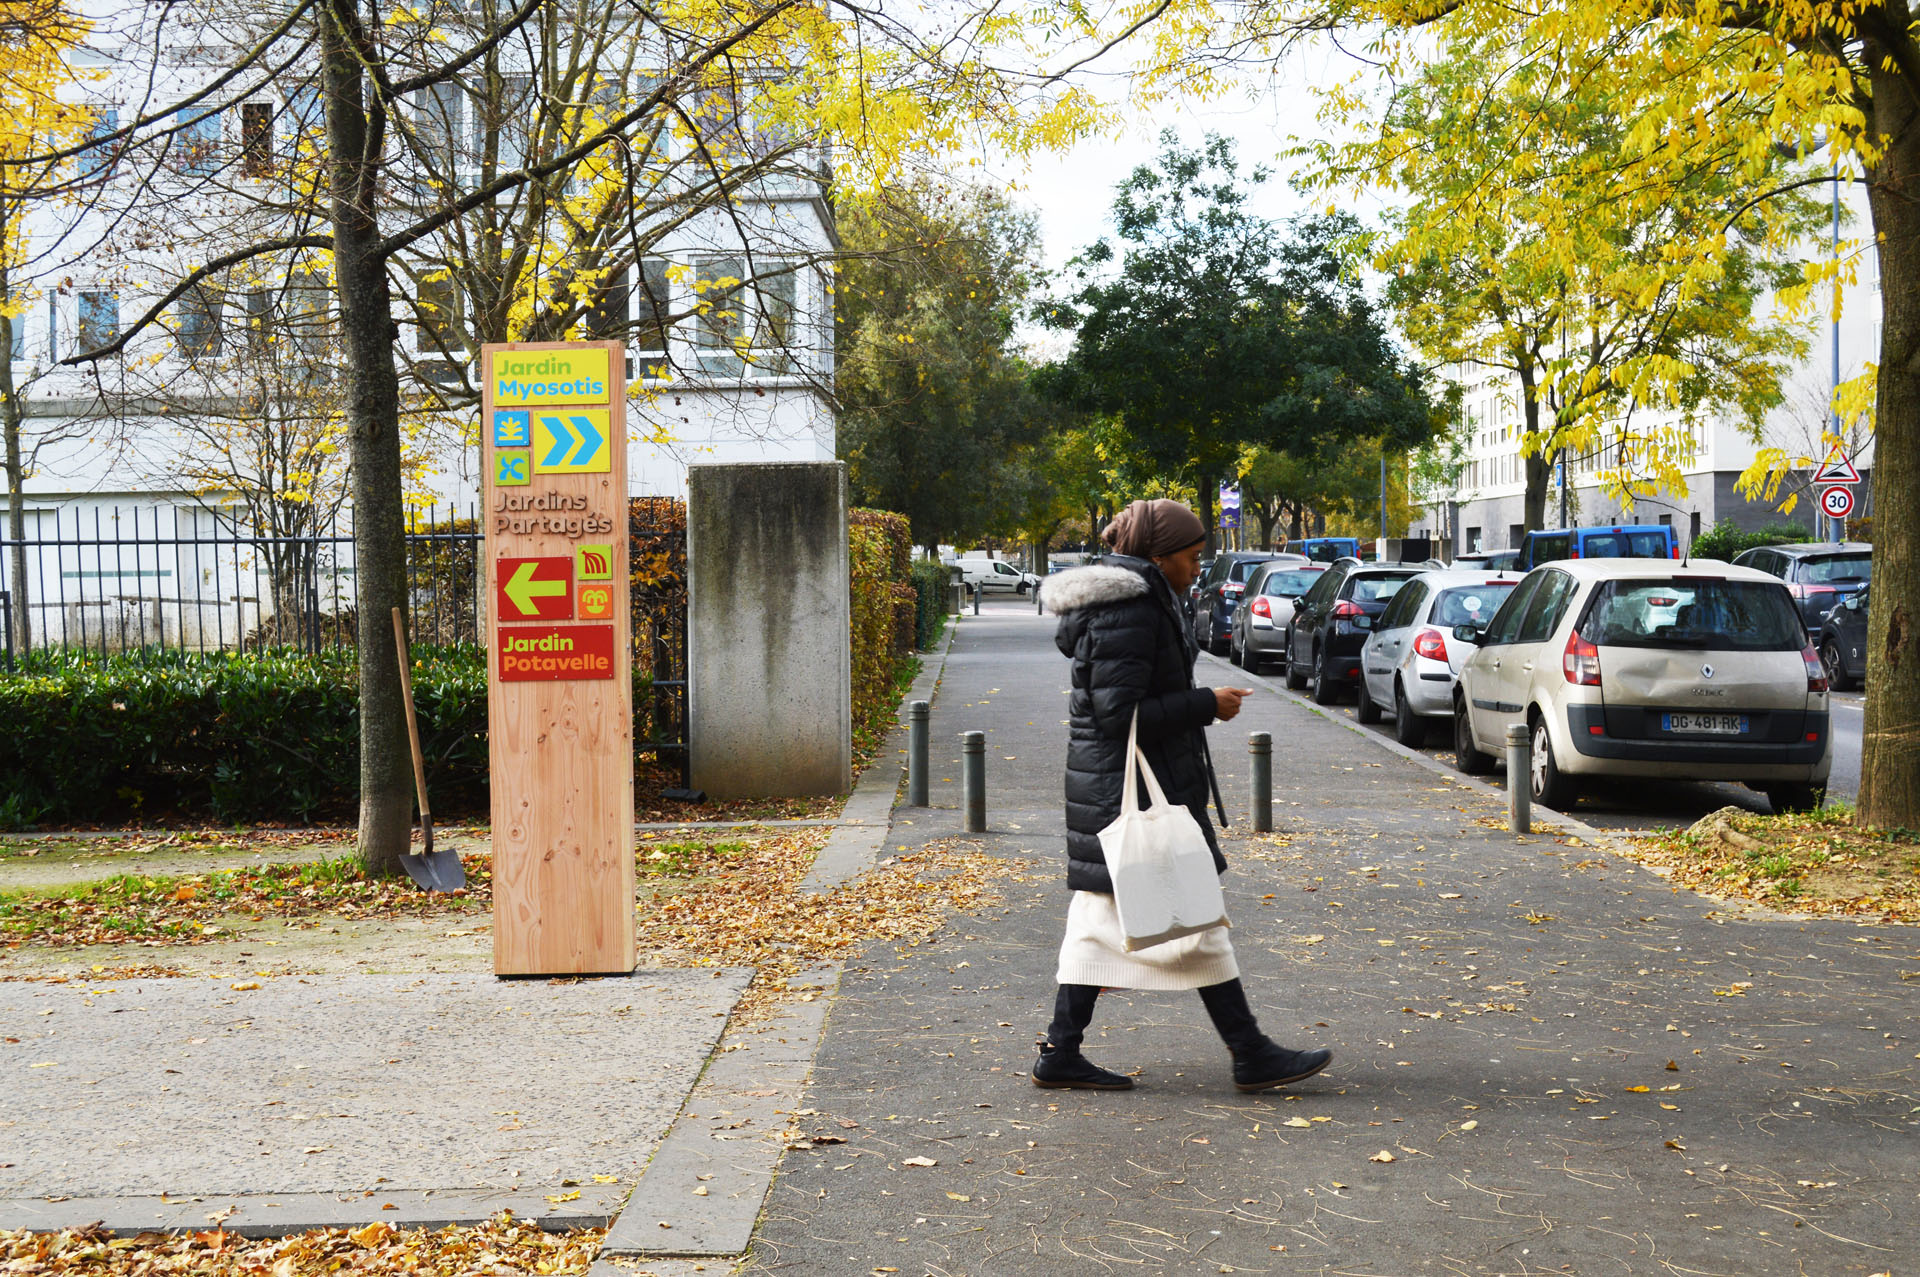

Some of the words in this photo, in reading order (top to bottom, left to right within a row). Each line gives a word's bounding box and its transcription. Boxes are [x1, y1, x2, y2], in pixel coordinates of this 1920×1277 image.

[498, 357, 571, 376] Jardin
[498, 376, 603, 400] Myosotis
[494, 490, 587, 512] Jardins
[1828, 495, 1847, 508] 30
[495, 511, 613, 539] Partagés
[503, 633, 573, 652] Jardin
[503, 654, 609, 672] Potavelle
